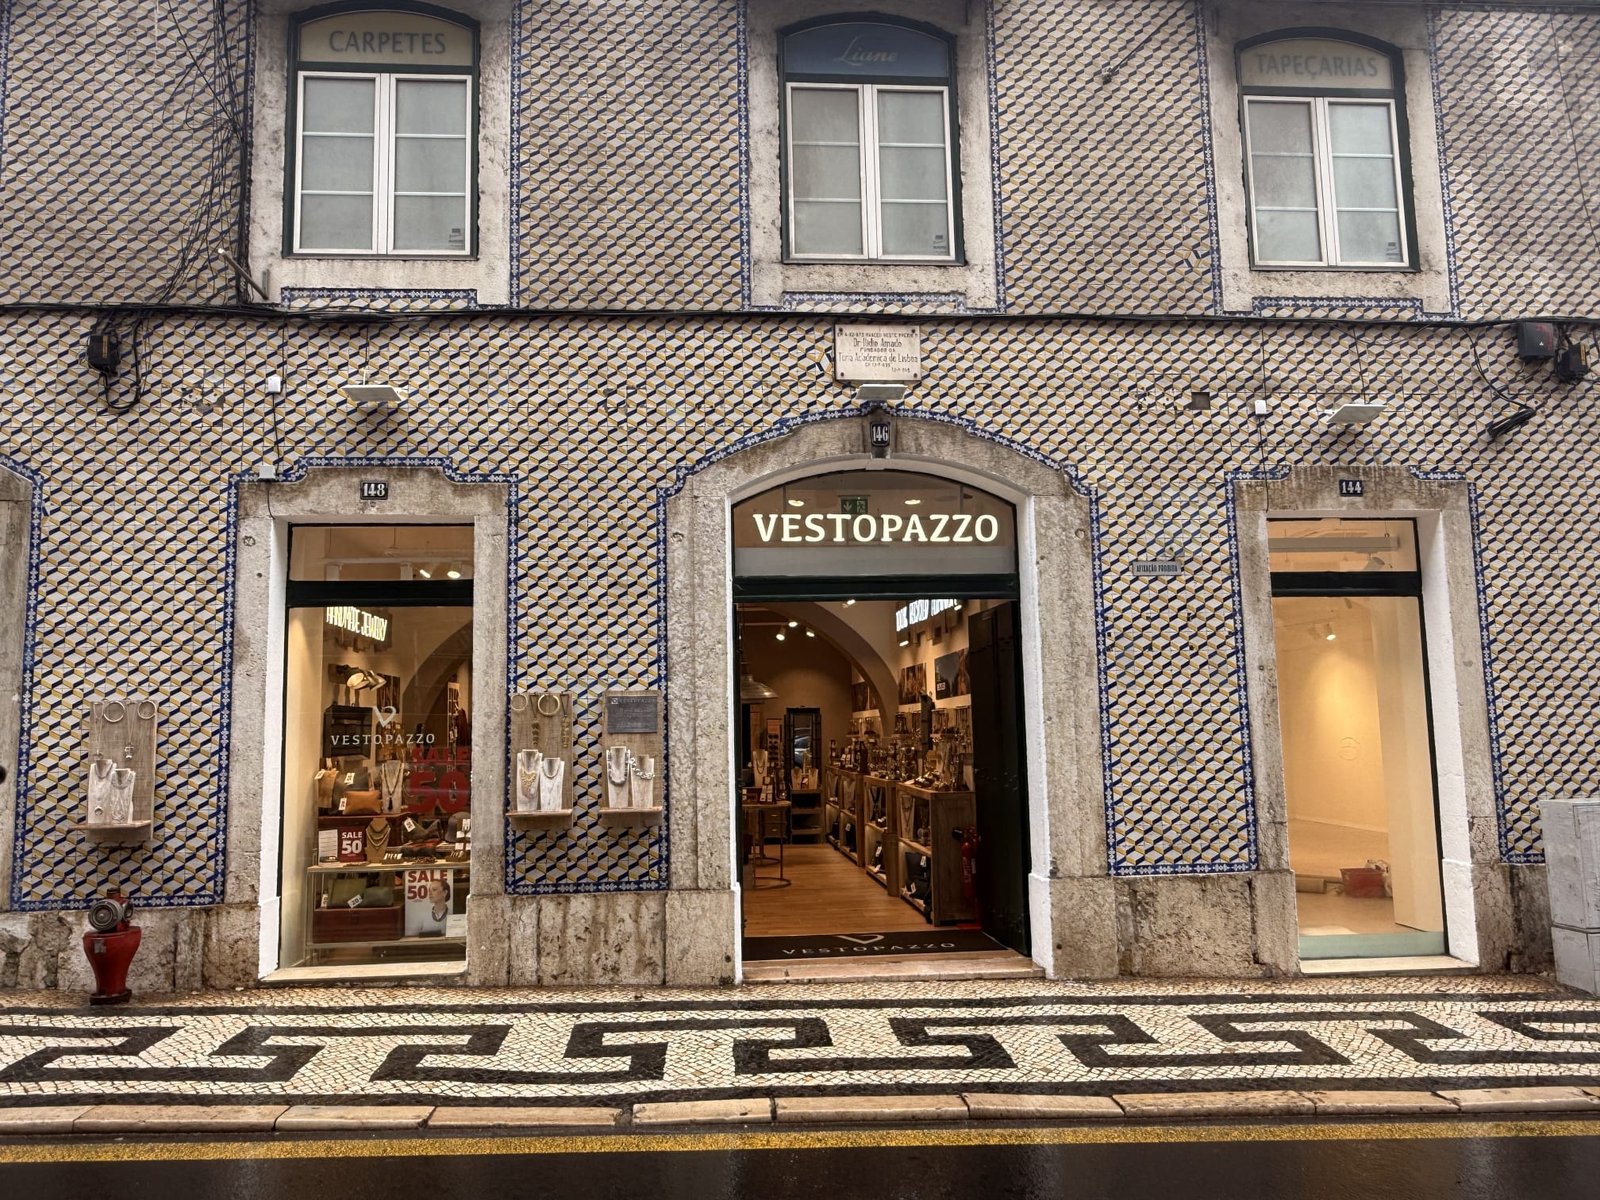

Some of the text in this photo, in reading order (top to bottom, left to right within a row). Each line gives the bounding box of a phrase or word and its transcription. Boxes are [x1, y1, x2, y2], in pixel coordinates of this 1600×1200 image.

[329, 30, 446, 54] CARPETES
[1256, 53, 1378, 80] TAPEÇARIAS
[873, 426, 888, 441] 146
[363, 483, 385, 497] 148
[1342, 481, 1361, 493] 144
[753, 514, 998, 542] VESTOPAZZO
[331, 733, 435, 745] VESTOPAZZO
[407, 869, 448, 883] SALE
[783, 942, 955, 955] VESTOPAZZO
